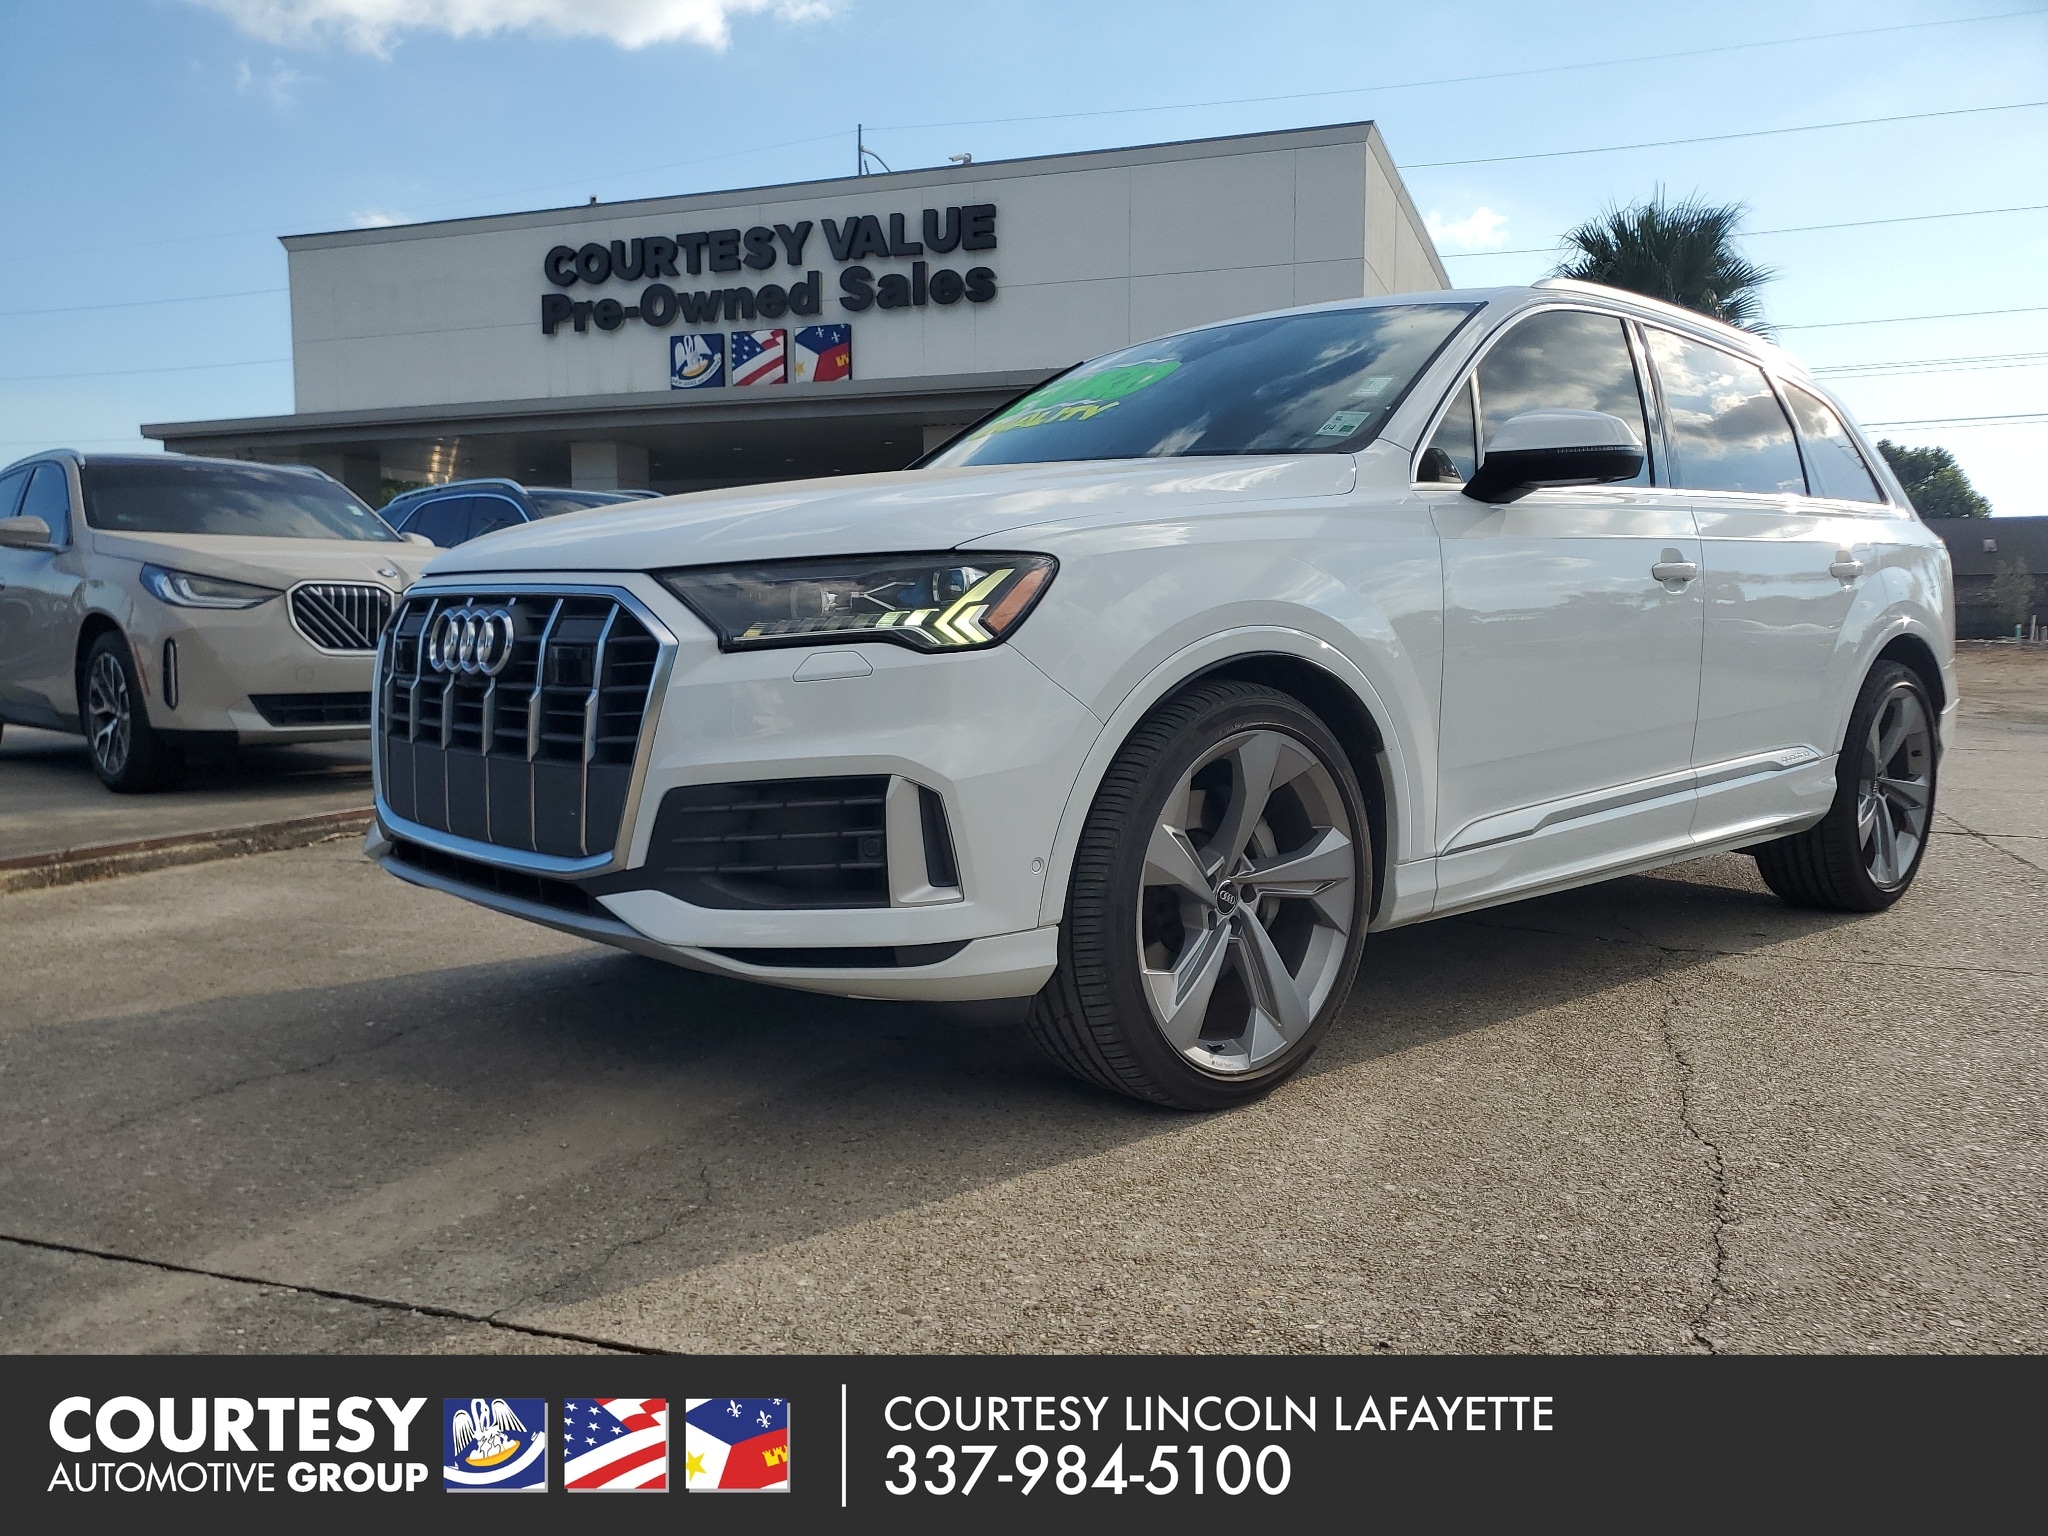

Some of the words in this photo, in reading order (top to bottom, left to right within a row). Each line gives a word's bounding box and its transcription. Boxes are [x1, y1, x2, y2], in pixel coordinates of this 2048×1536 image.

[544, 220, 814, 287] COURTESY
[821, 203, 998, 262] VALUE
[541, 269, 823, 335] Pre-Owned
[839, 260, 998, 312] Sales
